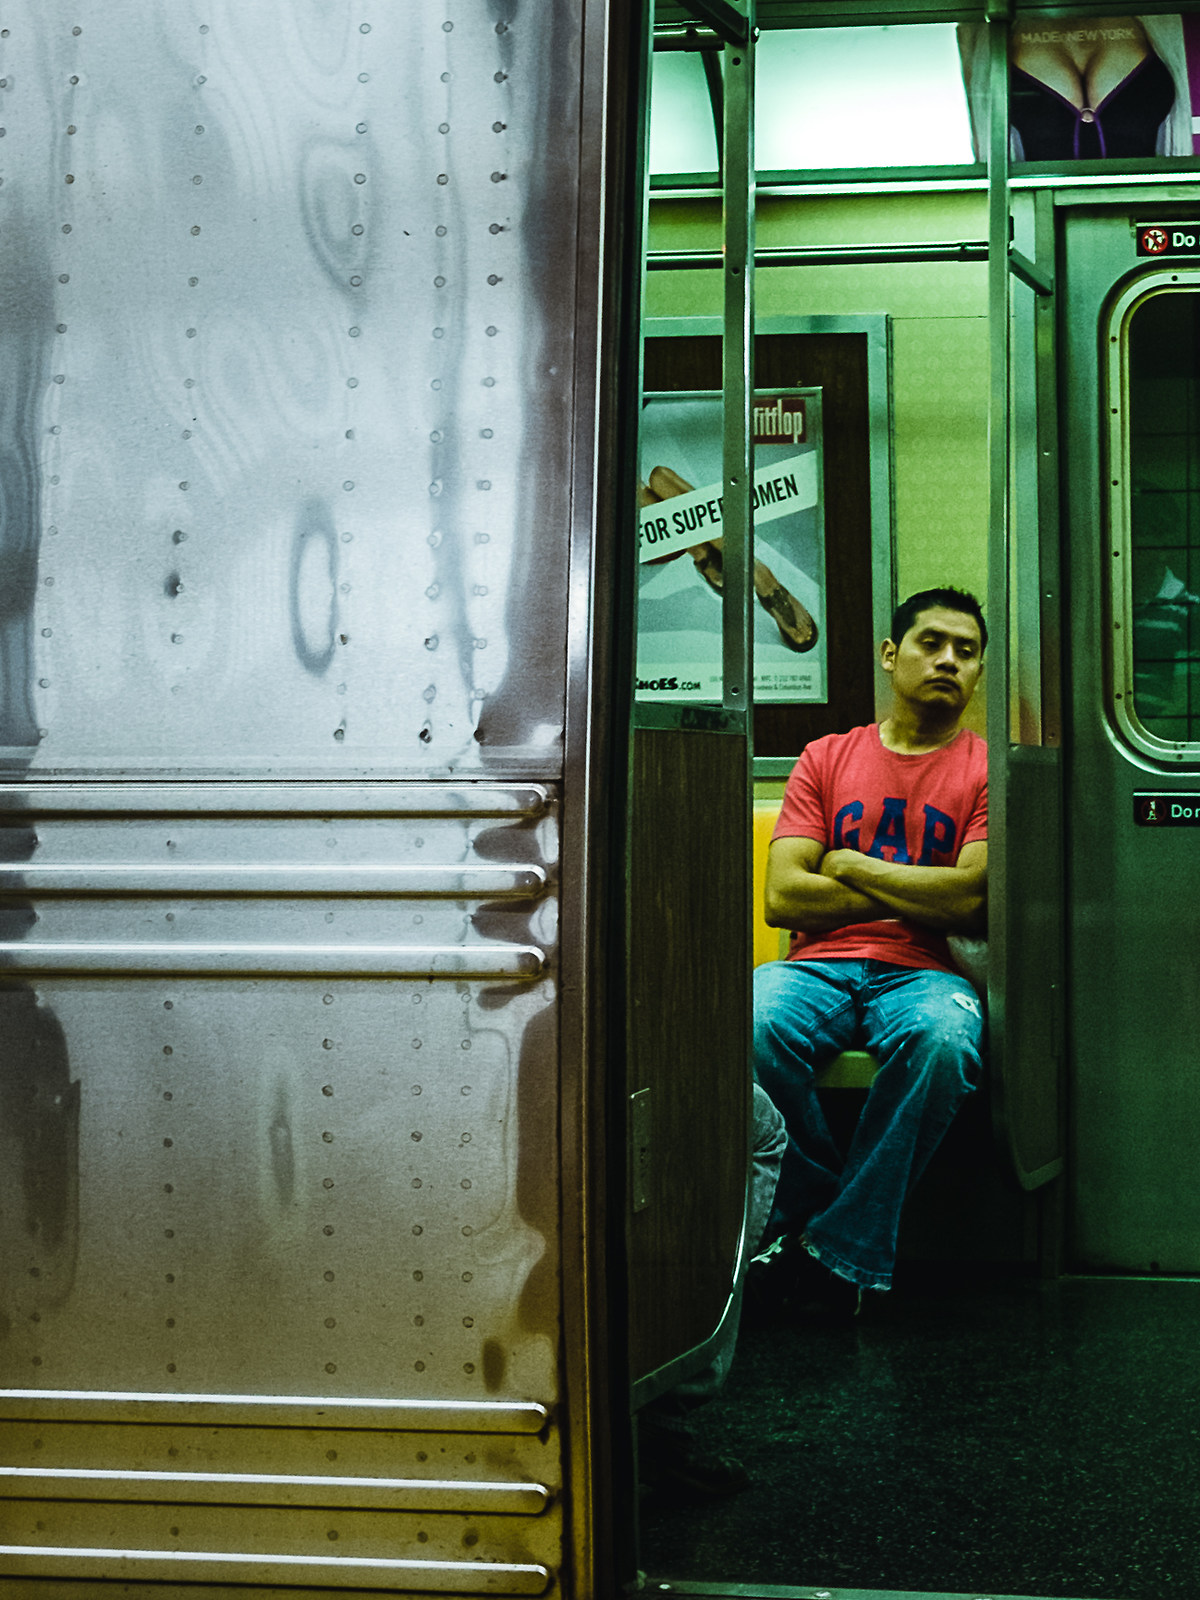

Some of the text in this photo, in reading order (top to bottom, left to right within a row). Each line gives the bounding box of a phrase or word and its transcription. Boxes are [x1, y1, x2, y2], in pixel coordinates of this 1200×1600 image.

[1021, 31, 1060, 43] MADE
[1065, 29, 1098, 41] NEW
[1099, 28, 1136, 40] YORK
[1172, 232, 1196, 247] Do
[753, 399, 802, 444] fitflop
[1171, 804, 1193, 818] Do
[833, 797, 957, 866] GAP
